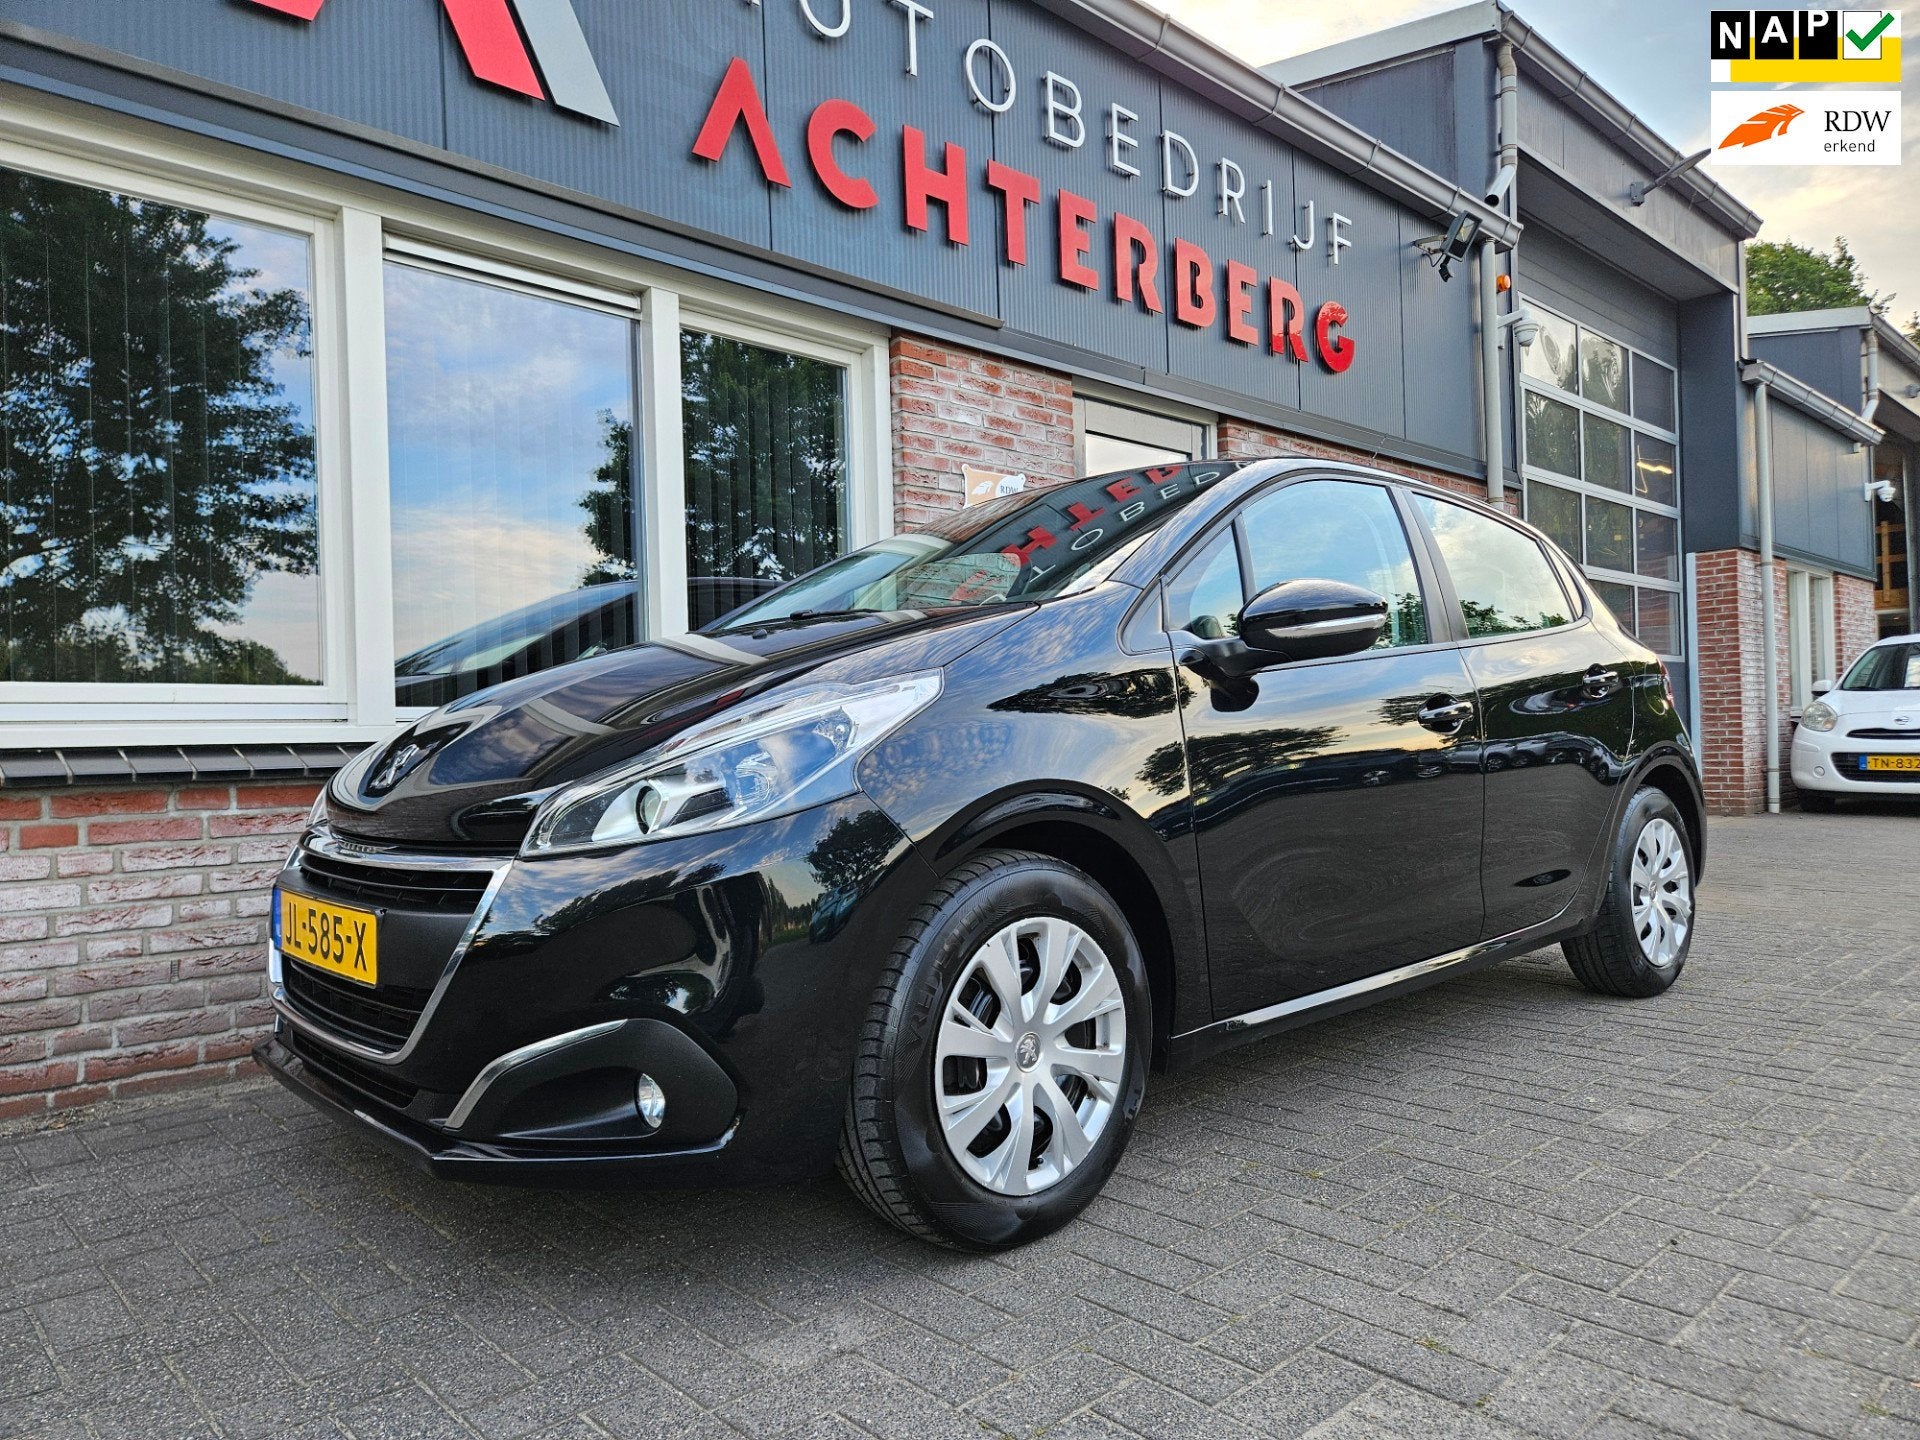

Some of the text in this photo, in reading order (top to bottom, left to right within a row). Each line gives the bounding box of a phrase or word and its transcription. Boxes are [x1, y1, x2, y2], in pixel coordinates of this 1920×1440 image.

[691, 56, 1356, 373] ACHTERBERG
[741, 0, 1353, 265] TOBEDRIJF
[1871, 757, 1920, 769] TN-832
[285, 902, 367, 972] JL-585-X
